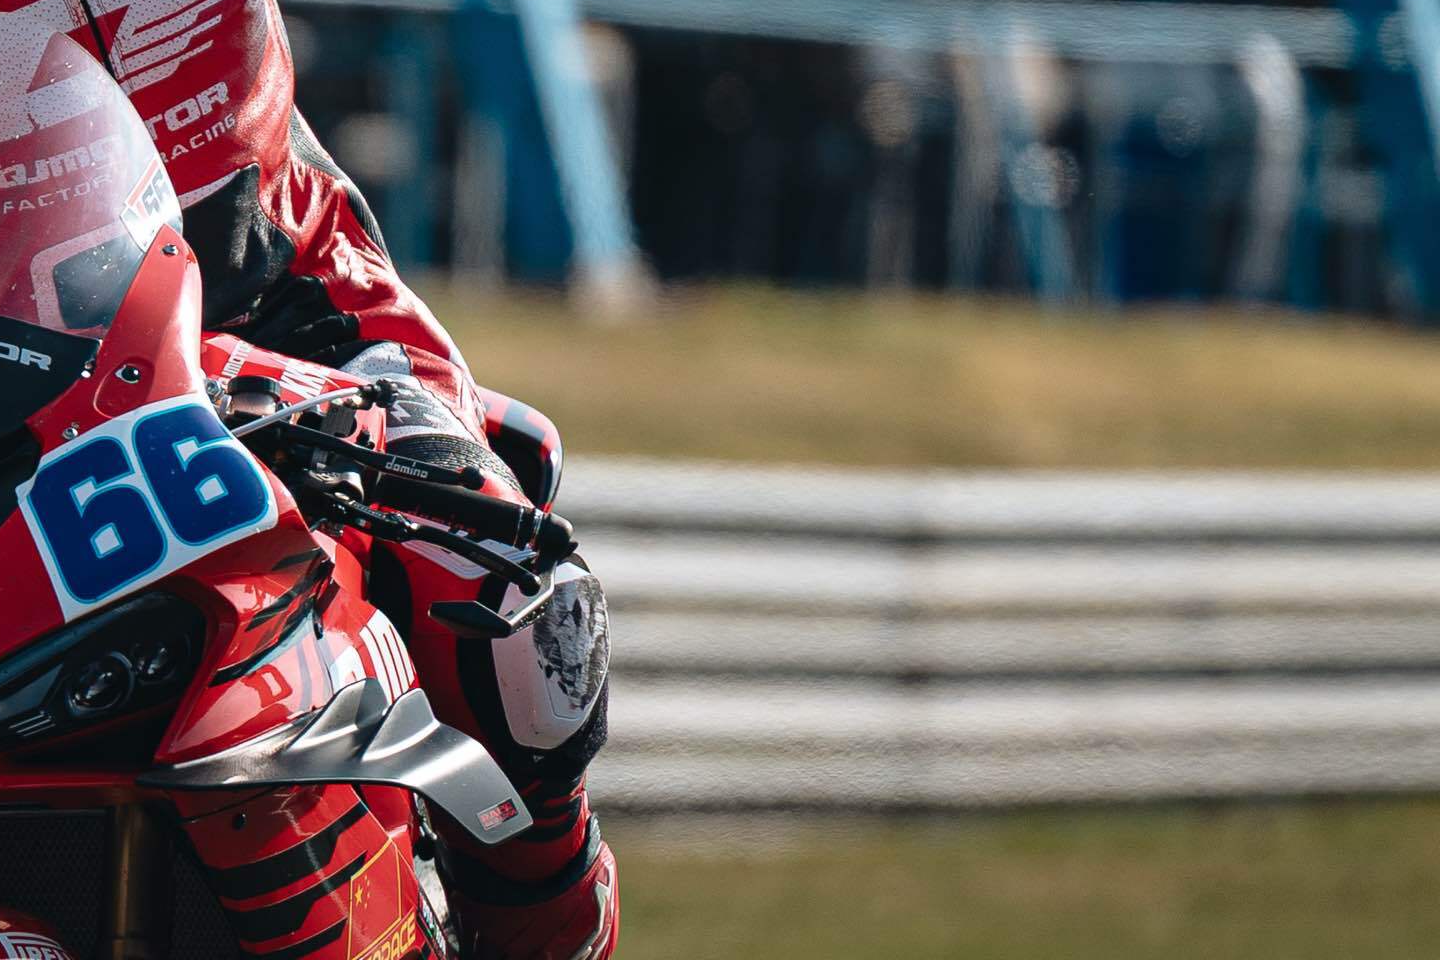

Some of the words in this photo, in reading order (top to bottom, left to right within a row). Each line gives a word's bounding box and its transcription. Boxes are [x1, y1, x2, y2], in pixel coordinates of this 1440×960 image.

[2, 174, 114, 215] FACTOR
[385, 457, 429, 480] domino
[26, 403, 270, 605] 66
